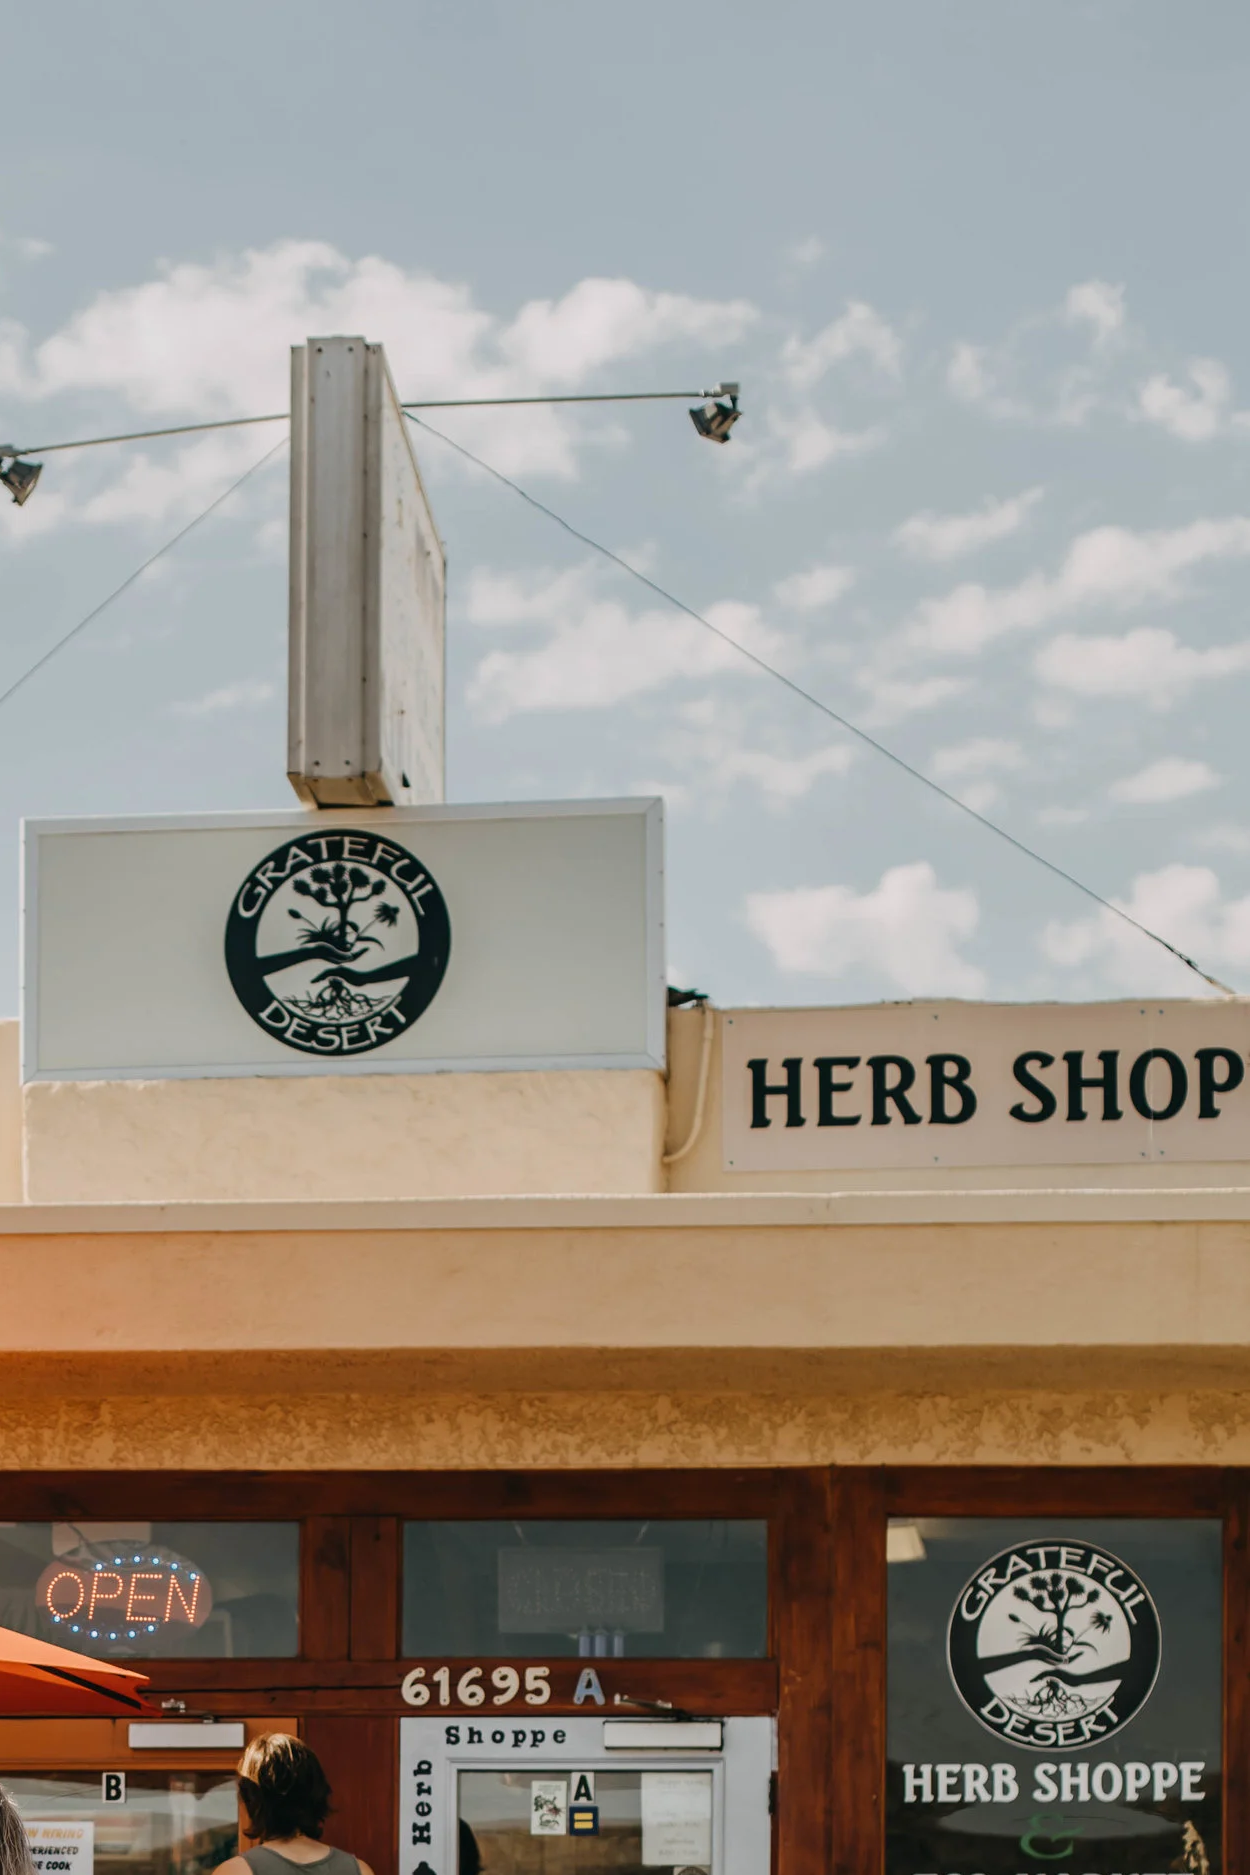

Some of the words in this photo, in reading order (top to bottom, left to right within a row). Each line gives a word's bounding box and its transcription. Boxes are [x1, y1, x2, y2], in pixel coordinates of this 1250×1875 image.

[236, 836, 442, 920] GRATEFUL
[258, 996, 410, 1051] DESERT
[746, 1053, 979, 1129] HERB
[1008, 1047, 1250, 1123] SHOP
[45, 1571, 201, 1624] OPEN
[960, 1545, 1149, 1625] GRATEFUL
[400, 1666, 552, 1707] 61695
[573, 1667, 606, 1706] A
[444, 1725, 567, 1748] Shoppe
[980, 1694, 1121, 1747] DESERT
[105, 1774, 122, 1802] B
[412, 1759, 433, 1846] Herb
[573, 1774, 593, 1802] A
[901, 1762, 1020, 1804] HERB
[1032, 1761, 1206, 1803] SHOPPE
[1019, 1811, 1084, 1860] &
[46, 1860, 72, 1871] COOK
